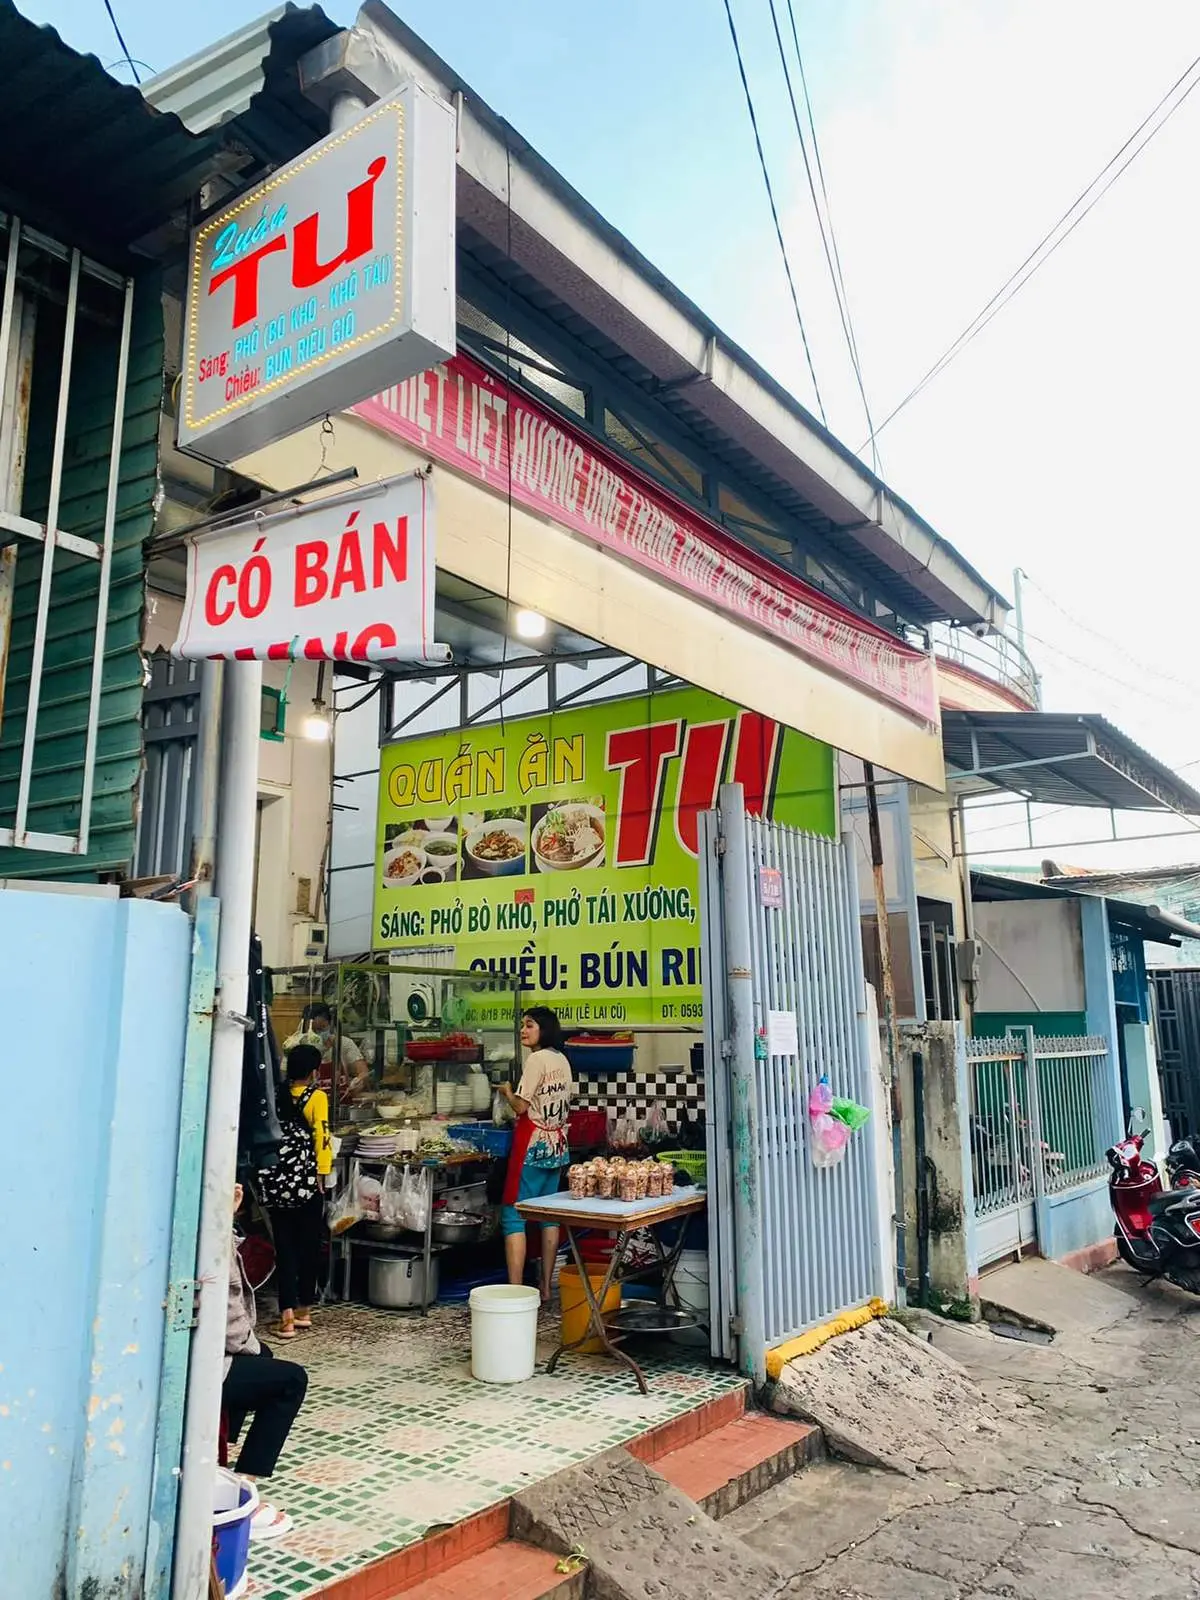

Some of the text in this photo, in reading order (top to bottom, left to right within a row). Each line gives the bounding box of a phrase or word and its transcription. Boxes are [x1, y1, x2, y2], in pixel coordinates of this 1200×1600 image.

[205, 510, 408, 627] CÓ BÁN
[388, 742, 505, 808] QUÁN
[517, 732, 585, 796] ĂN
[380, 909, 425, 939] SÁNG:
[430, 897, 464, 935] PHỞ
[468, 897, 491, 932] BÒ
[543, 887, 581, 928] PHỞ
[586, 888, 616, 924] TÁI
[622, 886, 696, 923] XƯƠNG,
[469, 940, 703, 993] CHIỀU: BÚN RI
